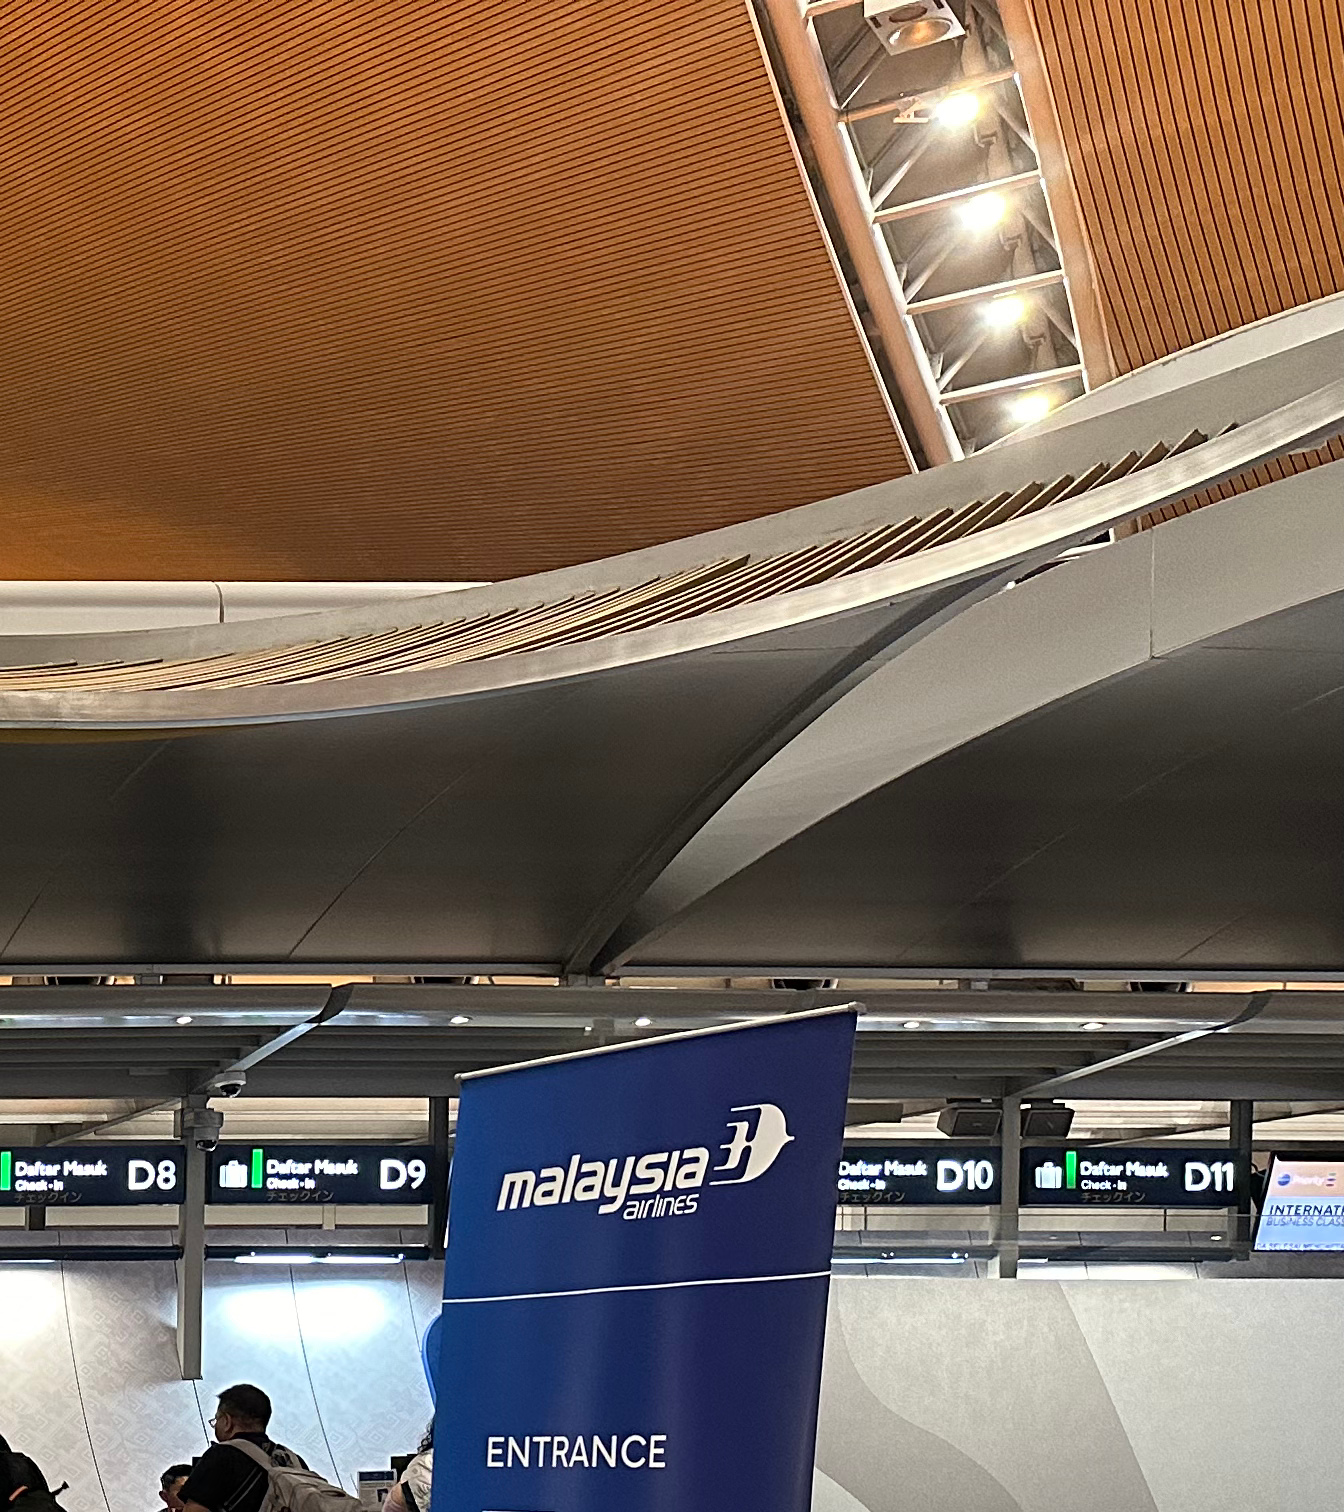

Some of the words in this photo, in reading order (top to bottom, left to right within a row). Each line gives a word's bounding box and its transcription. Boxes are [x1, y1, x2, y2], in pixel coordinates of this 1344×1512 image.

[15, 1161, 61, 1176] Daftar
[63, 1160, 107, 1176] Masuk
[128, 1160, 176, 1191] D8
[266, 1159, 312, 1174] Daftar
[314, 1159, 358, 1174] Masuk
[380, 1158, 426, 1190] D9
[496, 1145, 710, 1214] malaysia
[839, 1160, 882, 1176] Daftar
[884, 1160, 928, 1176] Masuk
[937, 1160, 993, 1191] D10
[1080, 1161, 1124, 1176] Daftar
[1126, 1162, 1169, 1177] Masuk
[1185, 1161, 1234, 1191] D11
[622, 1194, 700, 1220] airlines
[1270, 1205, 1344, 1216] INTERNATI
[1266, 1217, 1314, 1226] BUSINESS
[486, 1434, 667, 1469] ENTRANCE
